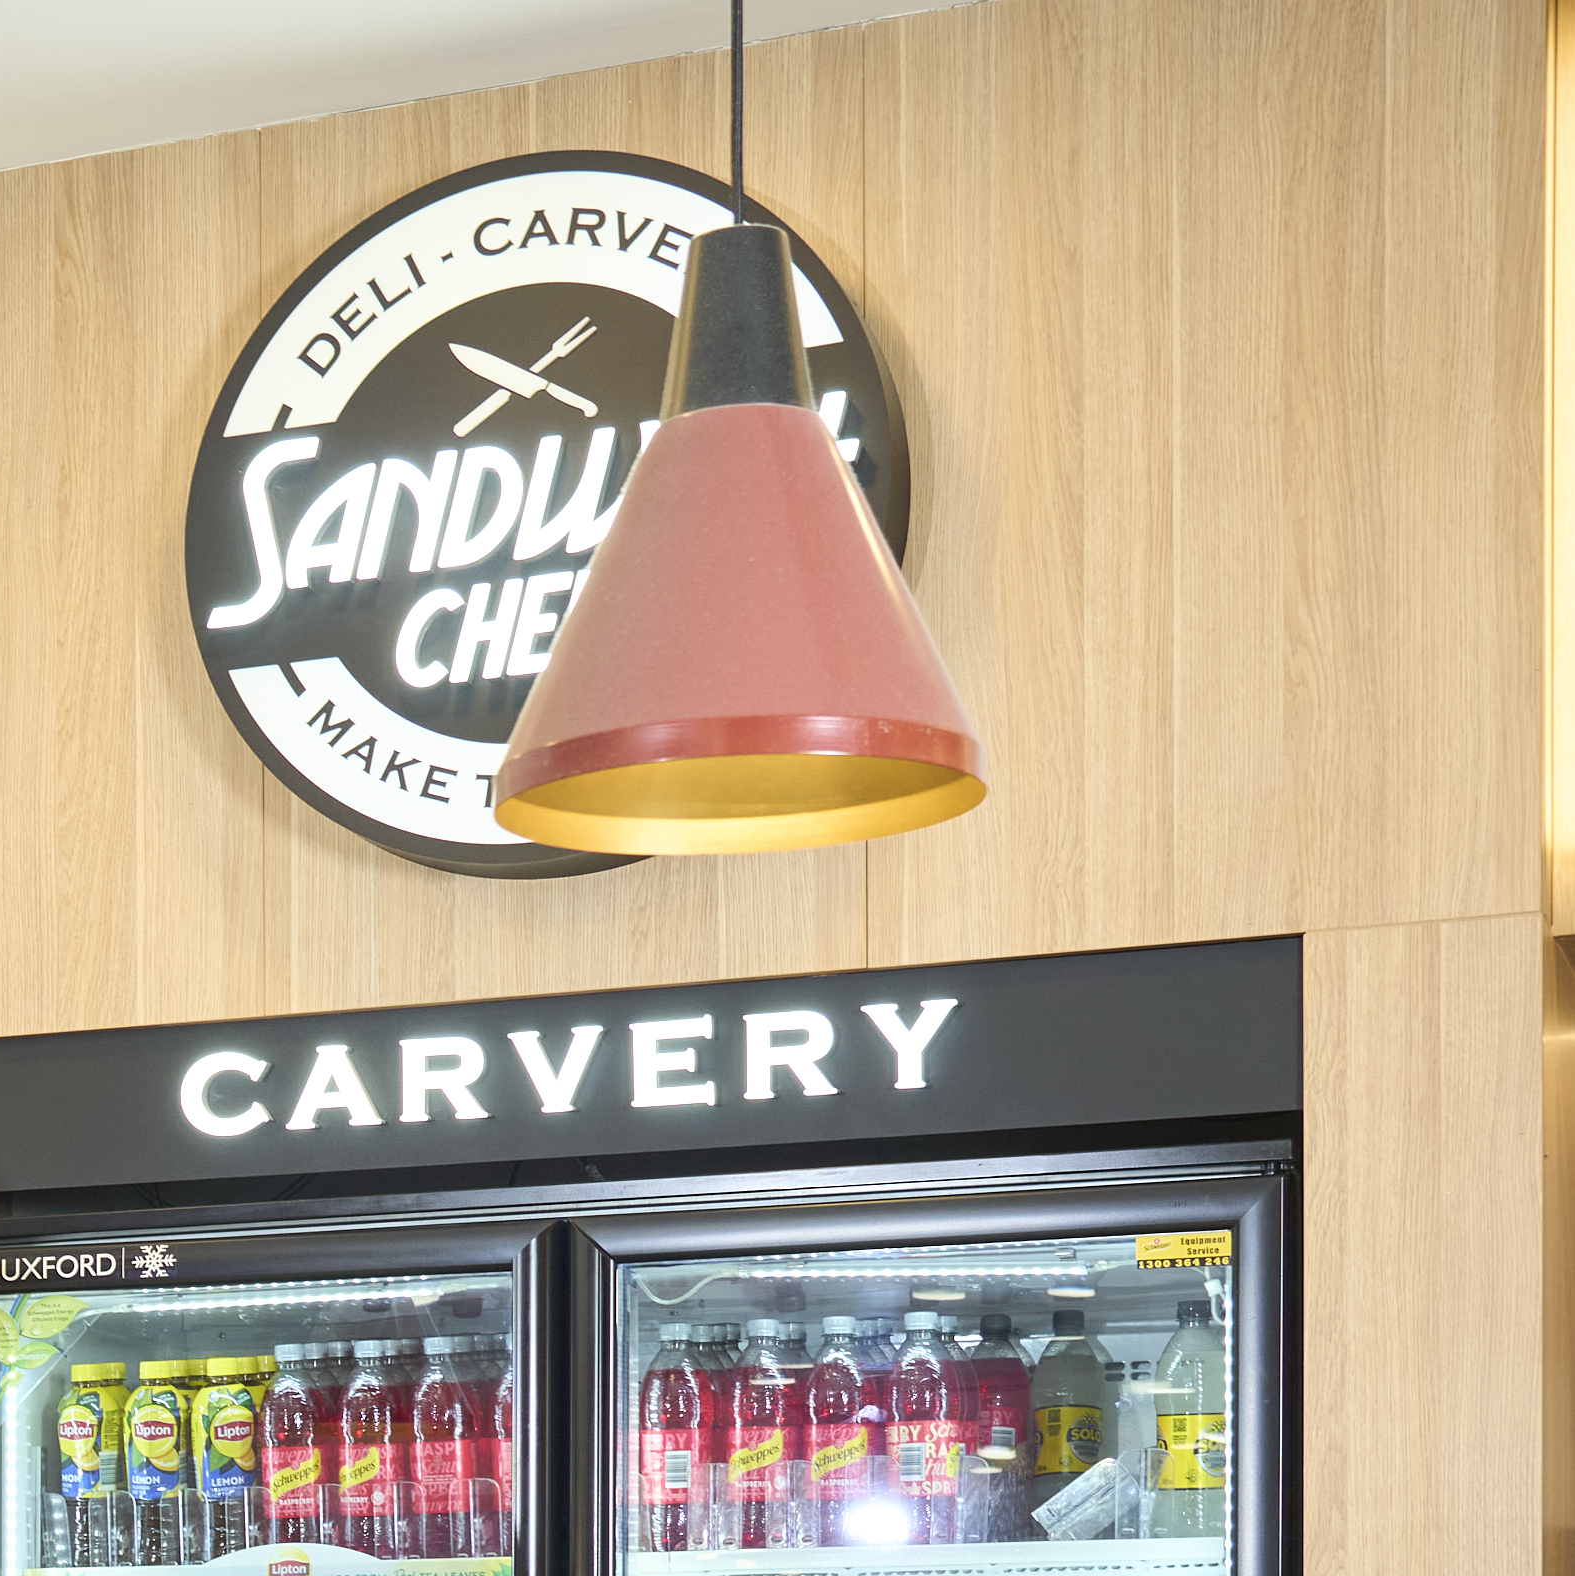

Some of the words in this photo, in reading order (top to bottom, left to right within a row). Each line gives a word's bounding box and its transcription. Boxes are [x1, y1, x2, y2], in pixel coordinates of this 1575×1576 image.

[297, 252, 427, 377] DELI
[472, 207, 695, 272] CARVE
[306, 699, 459, 807] MAKE
[177, 997, 961, 1140] CARVERY
[1180, 1236, 1226, 1247] Equipment
[1187, 1246, 1220, 1256] Service
[1138, 1259, 1172, 1269] 1300
[1175, 1257, 1201, 1267] 364
[1204, 1256, 1230, 1266] 246
[136, 1425, 172, 1437] Lipton
[218, 1425, 251, 1438] Lipton
[132, 1475, 161, 1486] LEMON
[272, 1563, 307, 1576] Lipton
